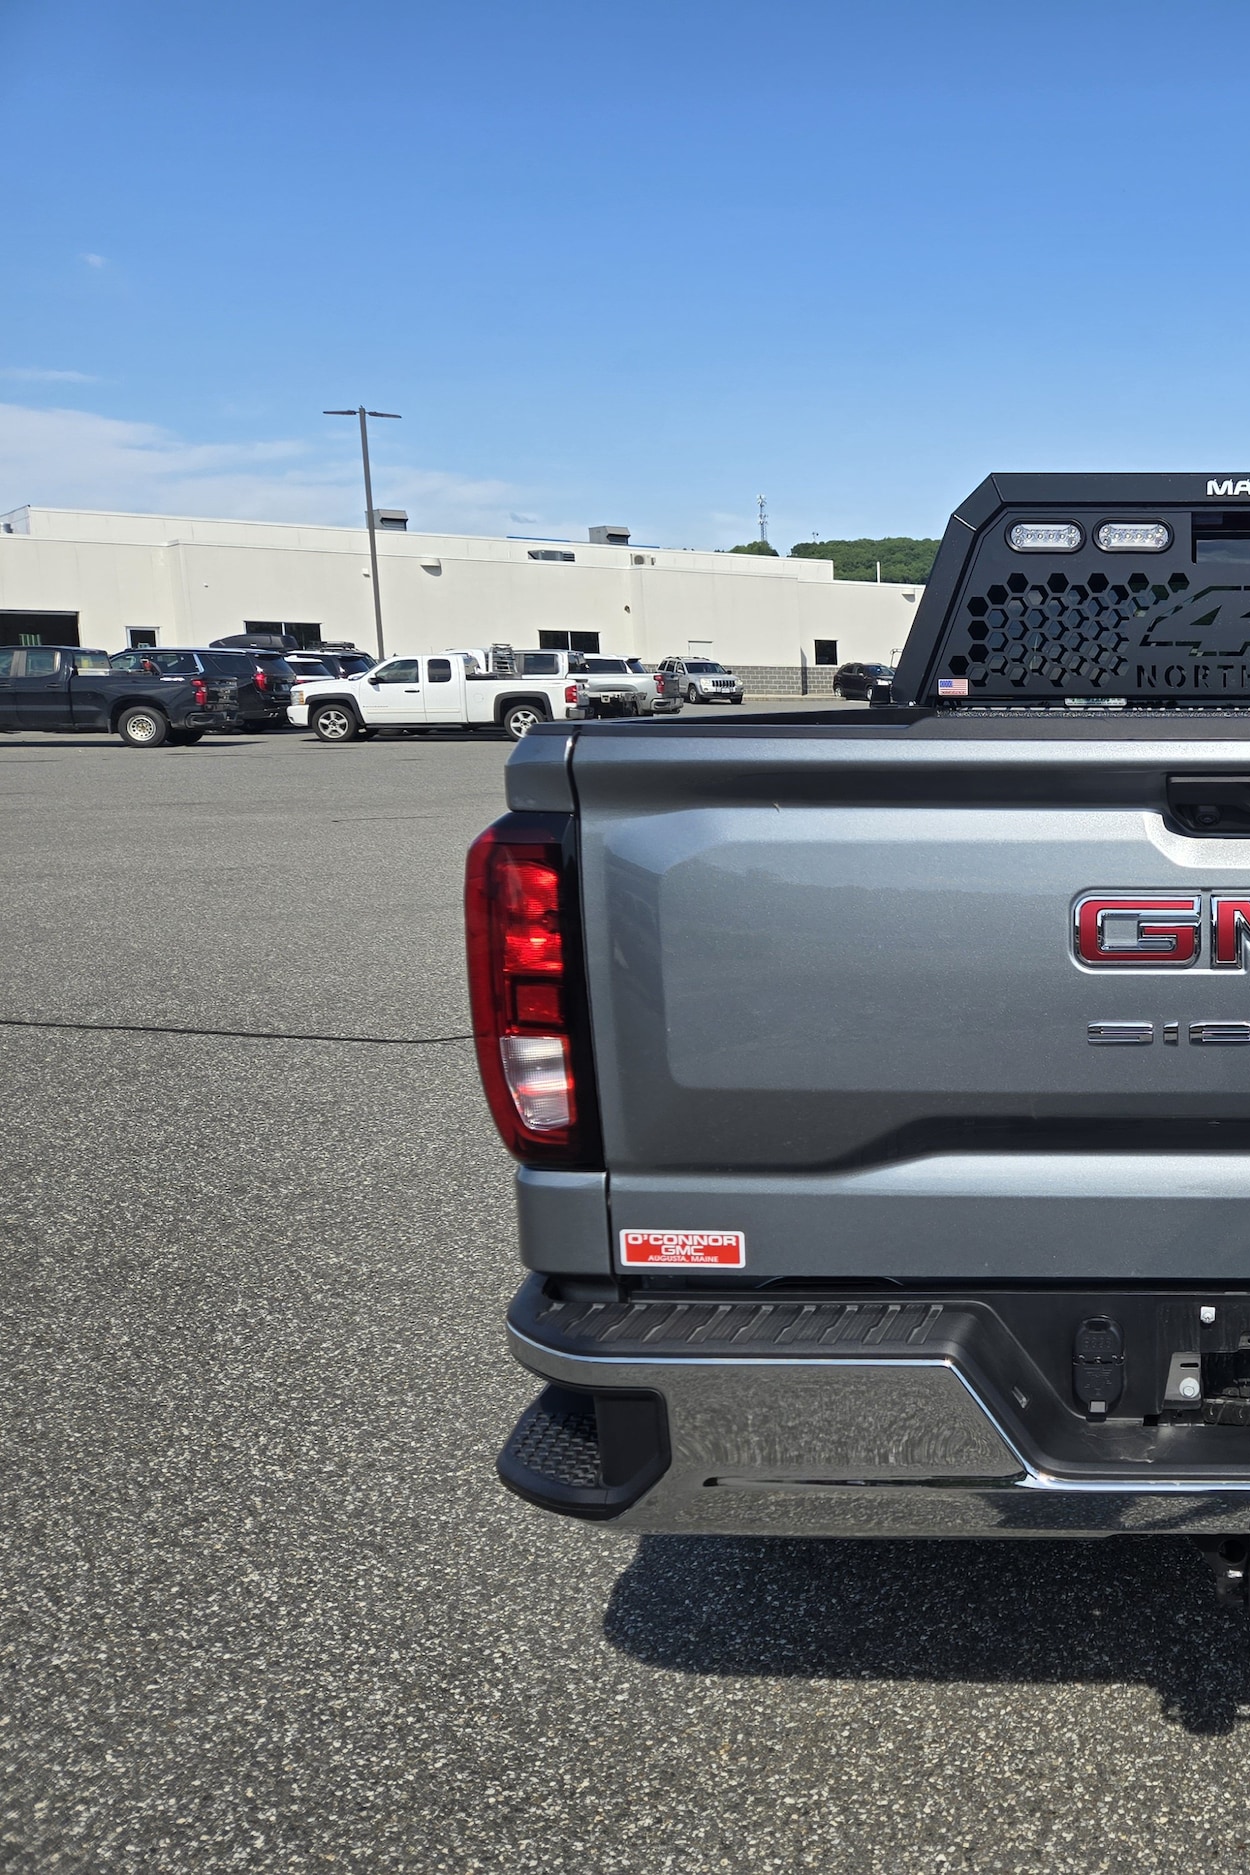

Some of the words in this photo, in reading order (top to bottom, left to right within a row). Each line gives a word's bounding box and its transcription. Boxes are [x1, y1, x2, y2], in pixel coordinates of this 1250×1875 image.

[627, 1233, 737, 1247] O'CONNOR
[661, 1244, 705, 1256] GMC
[690, 1255, 719, 1263] MAINE
